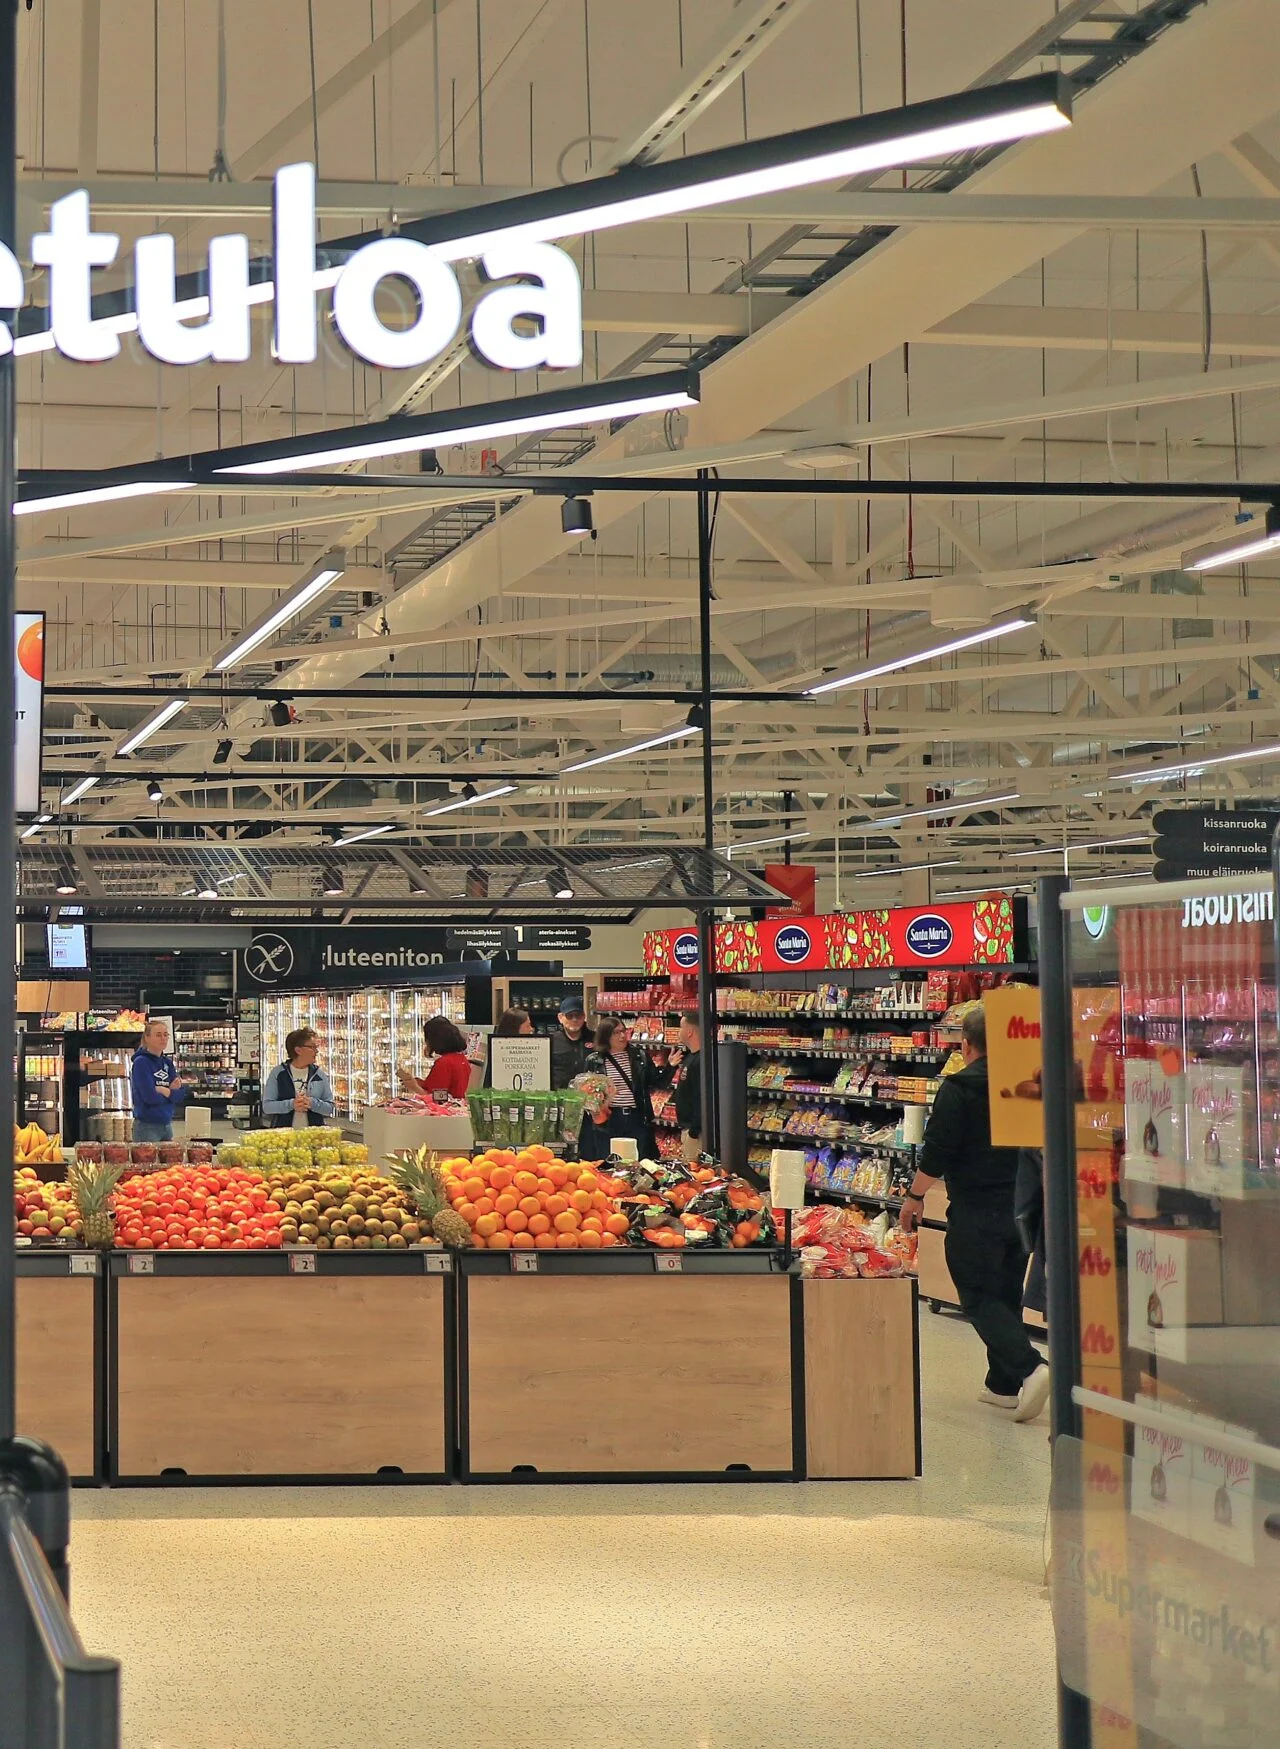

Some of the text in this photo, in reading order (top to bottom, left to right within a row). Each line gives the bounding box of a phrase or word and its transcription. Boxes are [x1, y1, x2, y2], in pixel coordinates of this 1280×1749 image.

[1204, 818, 1267, 829] kissanruoka
[1203, 842, 1267, 853] koiranruoka
[1187, 869, 1210, 877] muu
[513, 926, 523, 942] 1
[910, 926, 948, 941] Santa Maria
[778, 936, 807, 949] Santa Maria
[322, 945, 444, 970] luteeniton
